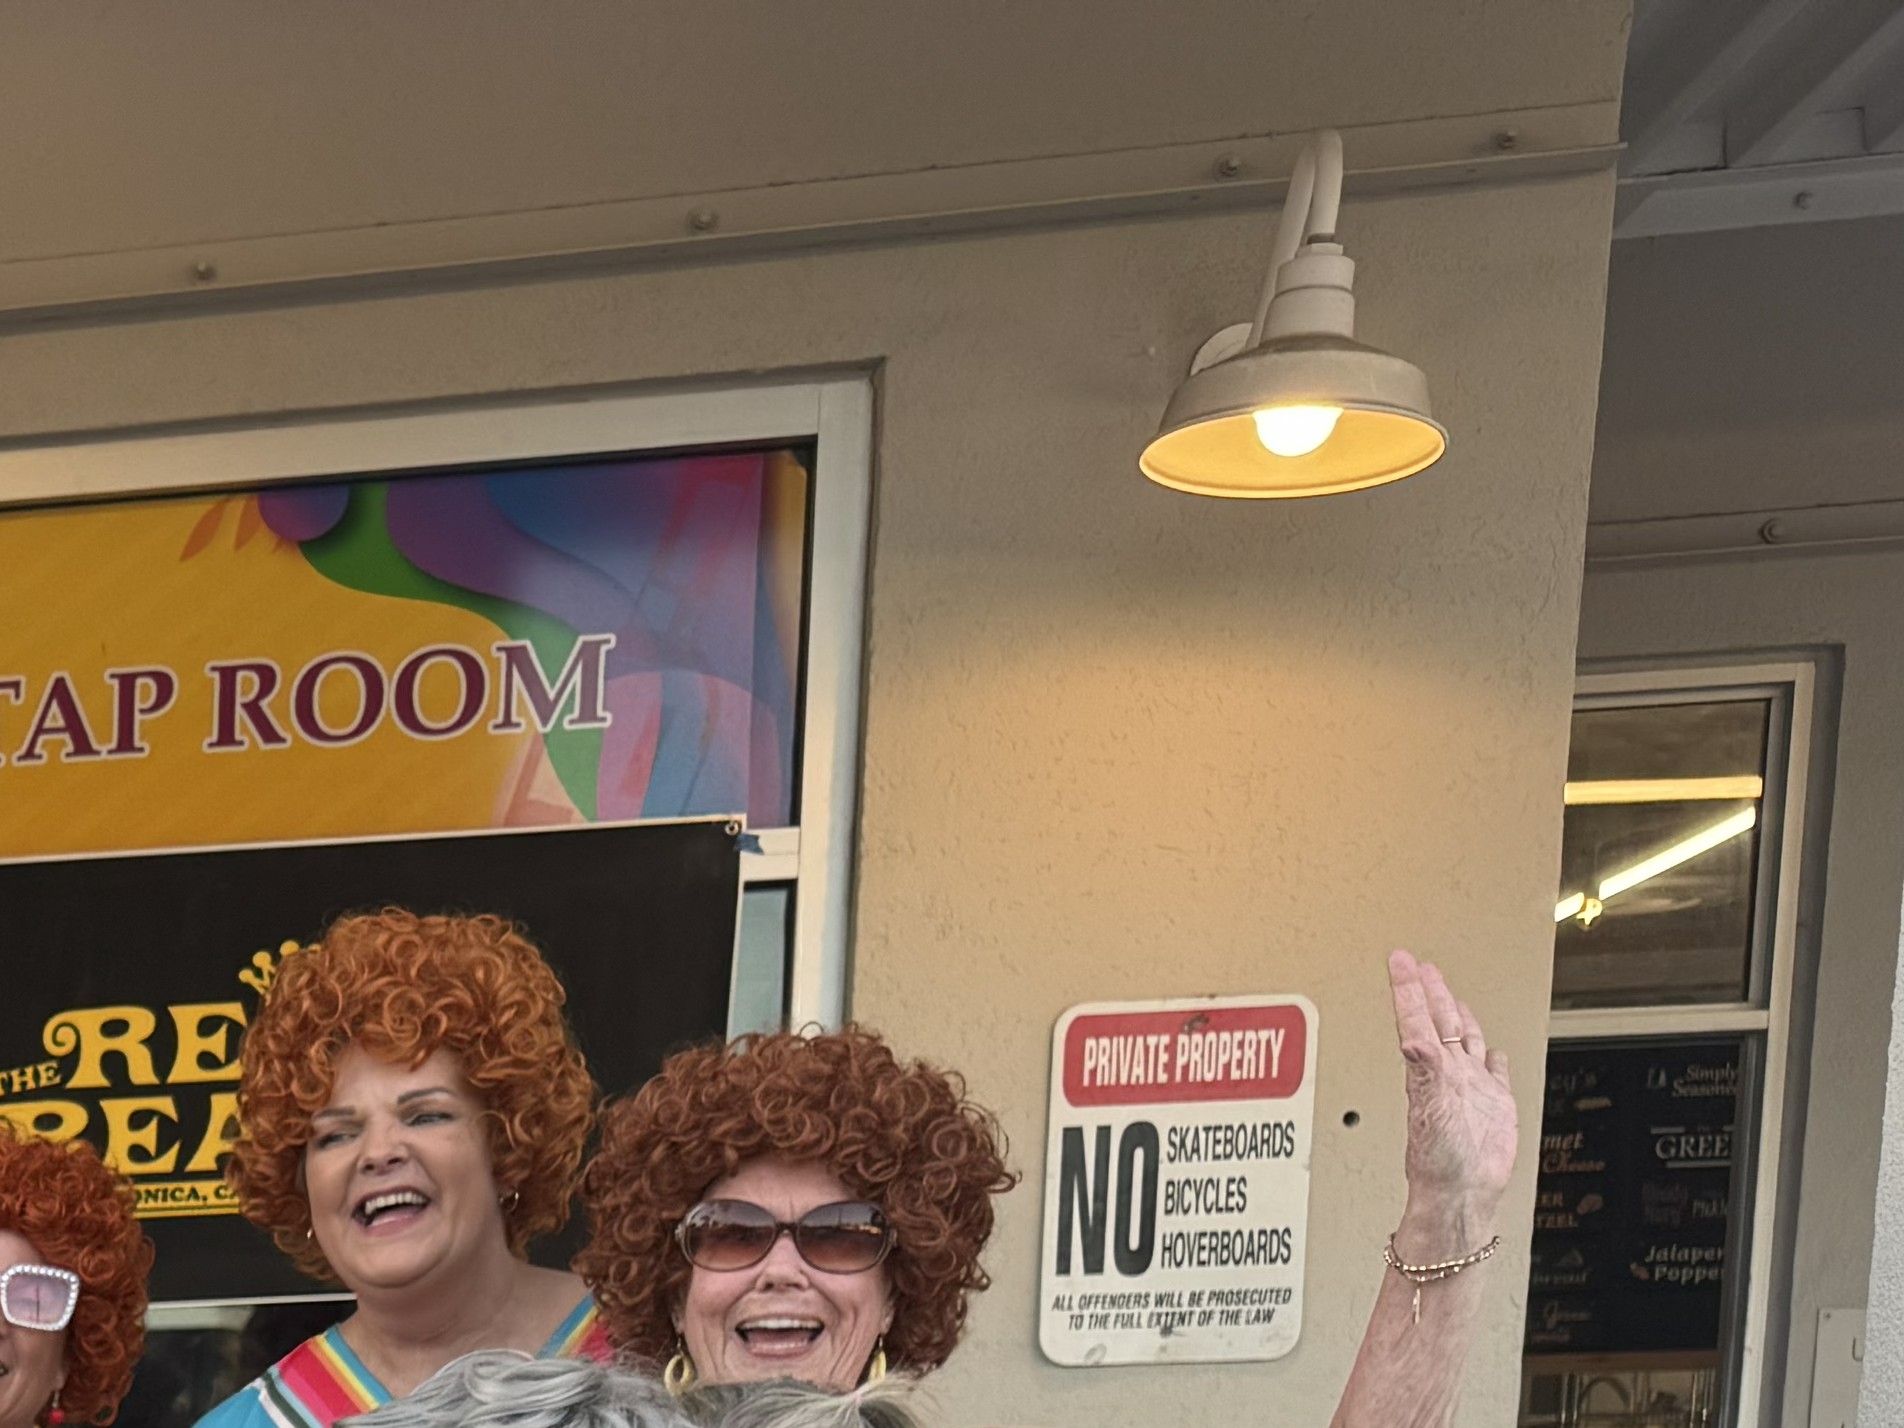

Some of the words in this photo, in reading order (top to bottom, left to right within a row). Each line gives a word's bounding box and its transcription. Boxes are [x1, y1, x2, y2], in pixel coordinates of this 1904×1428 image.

[203, 634, 616, 753] ROOM
[1083, 1034, 1170, 1087] PRIVATE
[1175, 1028, 1285, 1083] PROPERTY
[1167, 1120, 1295, 1163] SKATEBOARDS
[1055, 1121, 1160, 1277] NO
[1164, 1176, 1247, 1216] BICYCLES
[1161, 1227, 1292, 1268] HOVERBOARDS
[1051, 1294, 1074, 1312] ALL
[1078, 1290, 1150, 1311] OFFENDERS
[1154, 1289, 1183, 1309] WILL
[1188, 1289, 1203, 1308] BE
[1206, 1287, 1292, 1307] PROSECUTED
[1068, 1314, 1084, 1331] TO
[1088, 1312, 1110, 1330] THE
[1113, 1311, 1142, 1330] FULL
[1147, 1310, 1193, 1329] EXTENT
[1197, 1309, 1214, 1327] OF
[1219, 1309, 1240, 1326] THE
[1245, 1308, 1275, 1325] LAW
